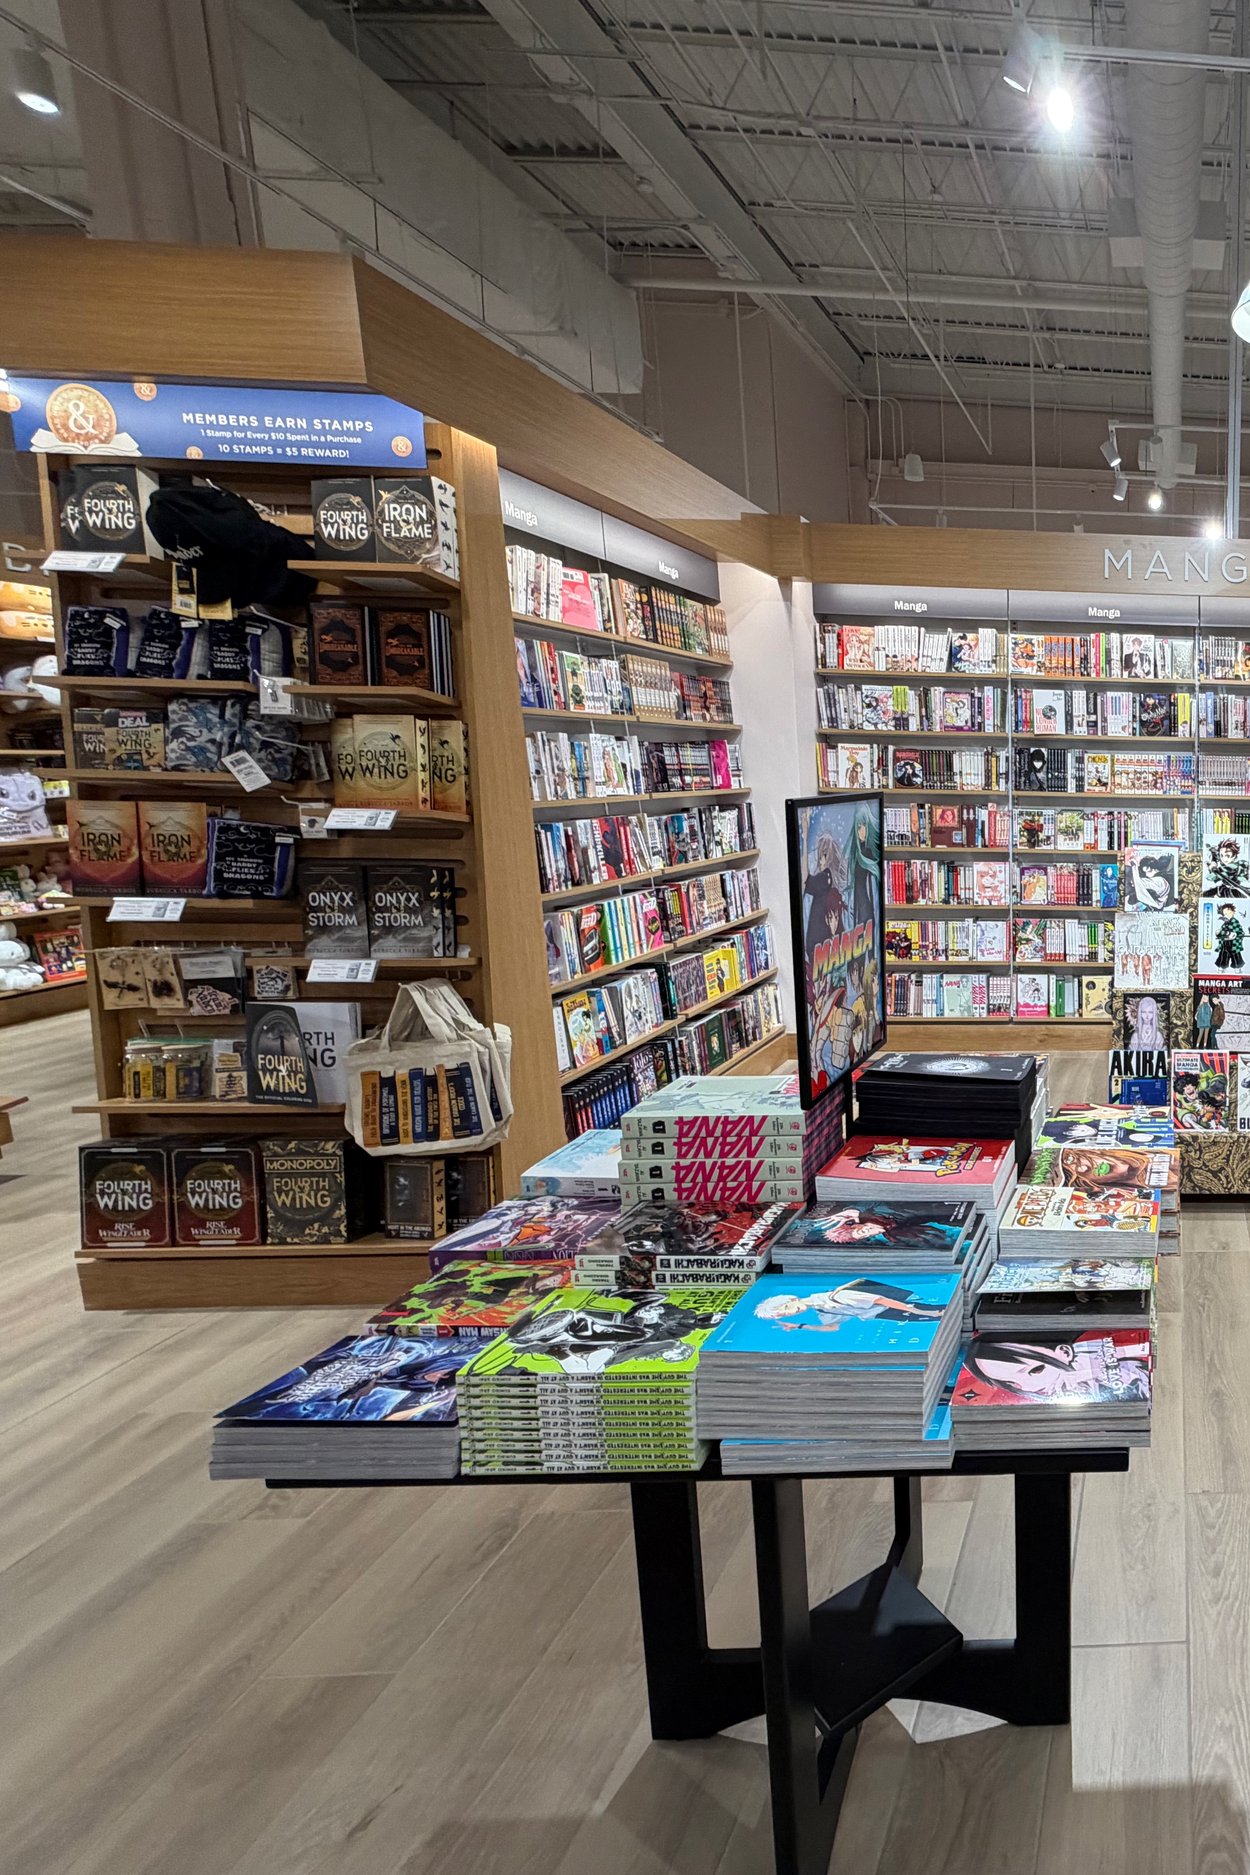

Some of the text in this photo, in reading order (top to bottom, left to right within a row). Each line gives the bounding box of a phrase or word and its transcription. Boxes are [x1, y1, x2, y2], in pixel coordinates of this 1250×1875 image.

[182, 412, 374, 432] MEMBERS EARN STAMPS
[206, 430, 232, 439] Stamp
[246, 431, 269, 441] Every
[270, 432, 285, 441] $10
[286, 433, 309, 443] Spent
[311, 434, 319, 442] in
[326, 435, 362, 444] Purchase
[218, 444, 350, 458] 10 STAMPS $5 REWARD!
[84, 498, 134, 513] FOURTH
[383, 504, 427, 521] IRON
[504, 500, 538, 527] Manga
[85, 512, 136, 529] WING
[320, 509, 367, 524] FOURTH
[320, 523, 369, 540] WING
[383, 523, 433, 539] FLAME
[658, 561, 680, 579] Manga
[894, 600, 928, 614] Manga
[1088, 606, 1121, 620] Manga
[118, 714, 150, 728] DEAL
[116, 729, 150, 741] FOURTH
[118, 738, 151, 750] WING
[359, 749, 407, 763] FOURTH
[360, 763, 409, 780] WING
[81, 832, 122, 848] IRON
[79, 849, 127, 863] FLAME
[308, 891, 354, 907] ONYX
[308, 913, 358, 927] STORM
[813, 918, 873, 983] MANGA
[1198, 979, 1243, 988] MANGA ART
[257, 1054, 305, 1072] FOURTH
[1110, 1050, 1167, 1076] AKIRA
[258, 1071, 307, 1095] WING
[674, 1115, 768, 1137] NANA
[672, 1137, 766, 1159] NANA
[266, 1158, 338, 1171] MONOPOLY
[95, 1180, 152, 1193] FOURTH
[273, 1177, 329, 1192] FOURTH
[95, 1192, 153, 1211] WING
[273, 1190, 331, 1209] WING
